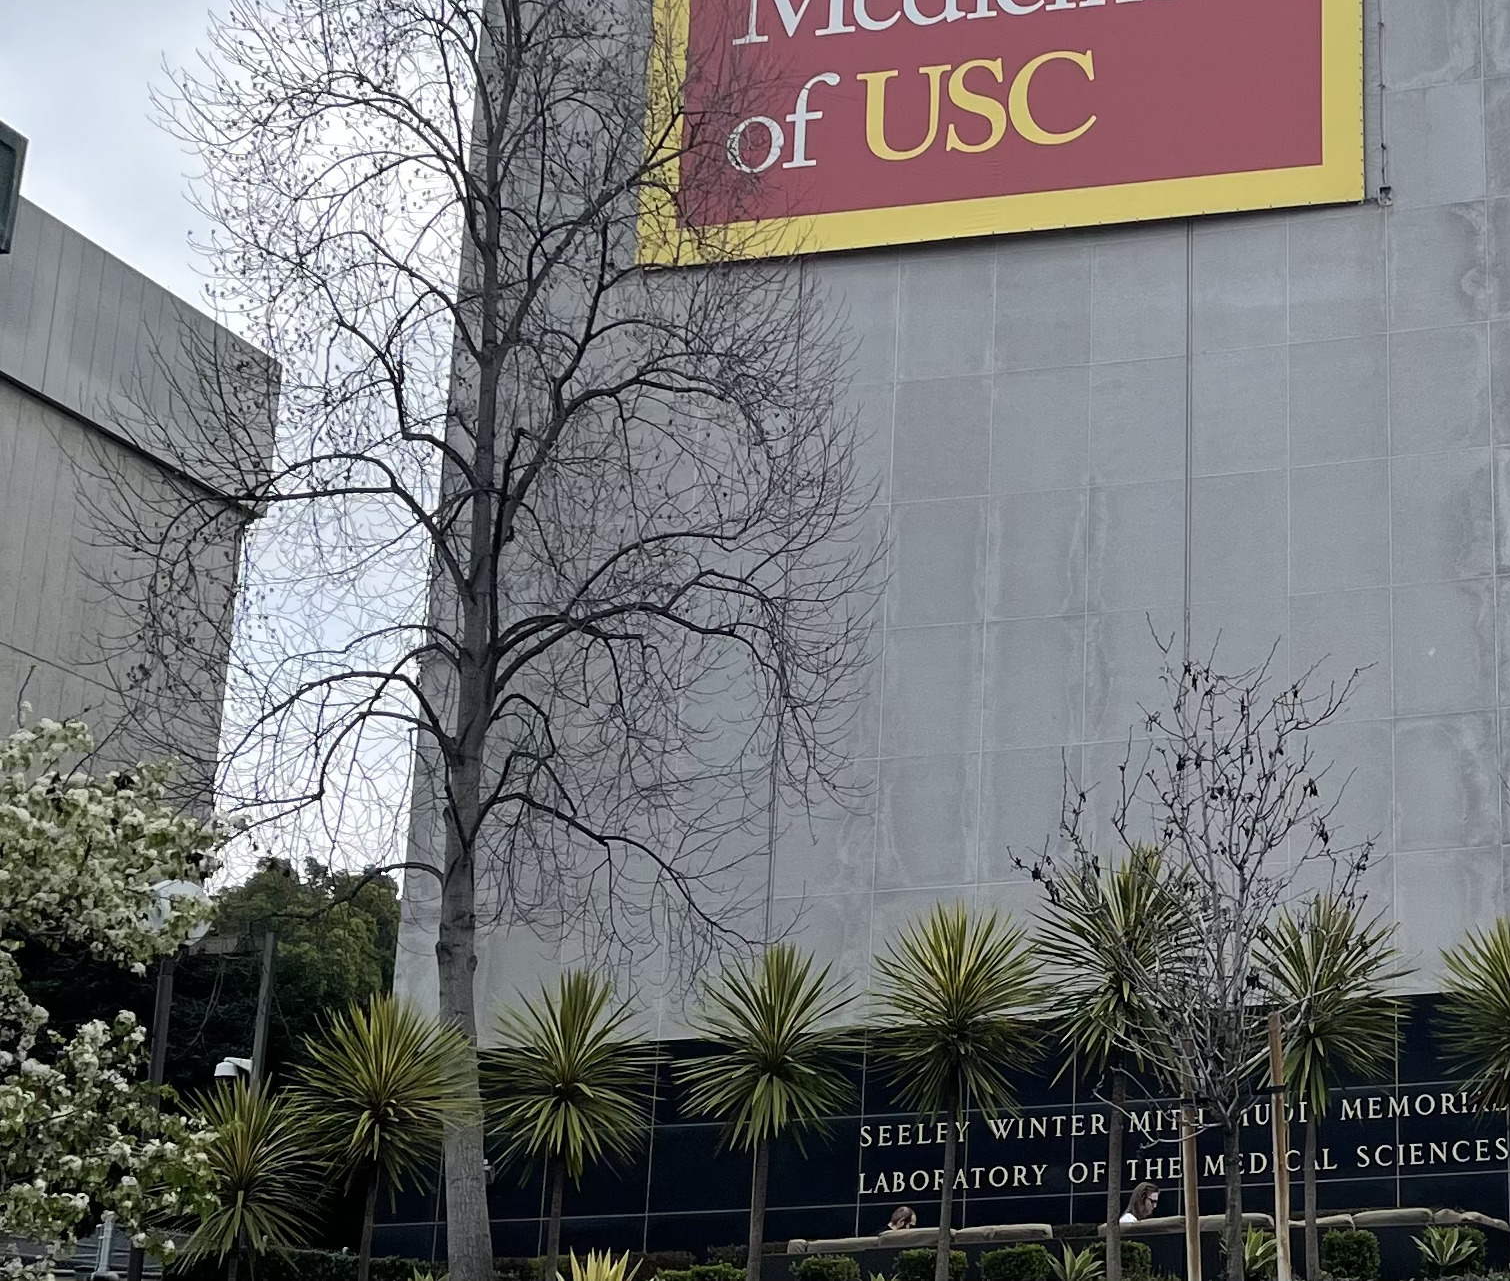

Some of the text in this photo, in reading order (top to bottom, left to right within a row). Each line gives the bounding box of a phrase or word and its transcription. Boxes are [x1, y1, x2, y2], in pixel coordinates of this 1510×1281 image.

[725, 49, 1097, 174] of USC
[860, 1121, 971, 1148] SEELEY
[1340, 1091, 1509, 1121] MEMORI
[859, 1137, 1509, 1194] LABORATORY OF THE MDCL SCIENCES
